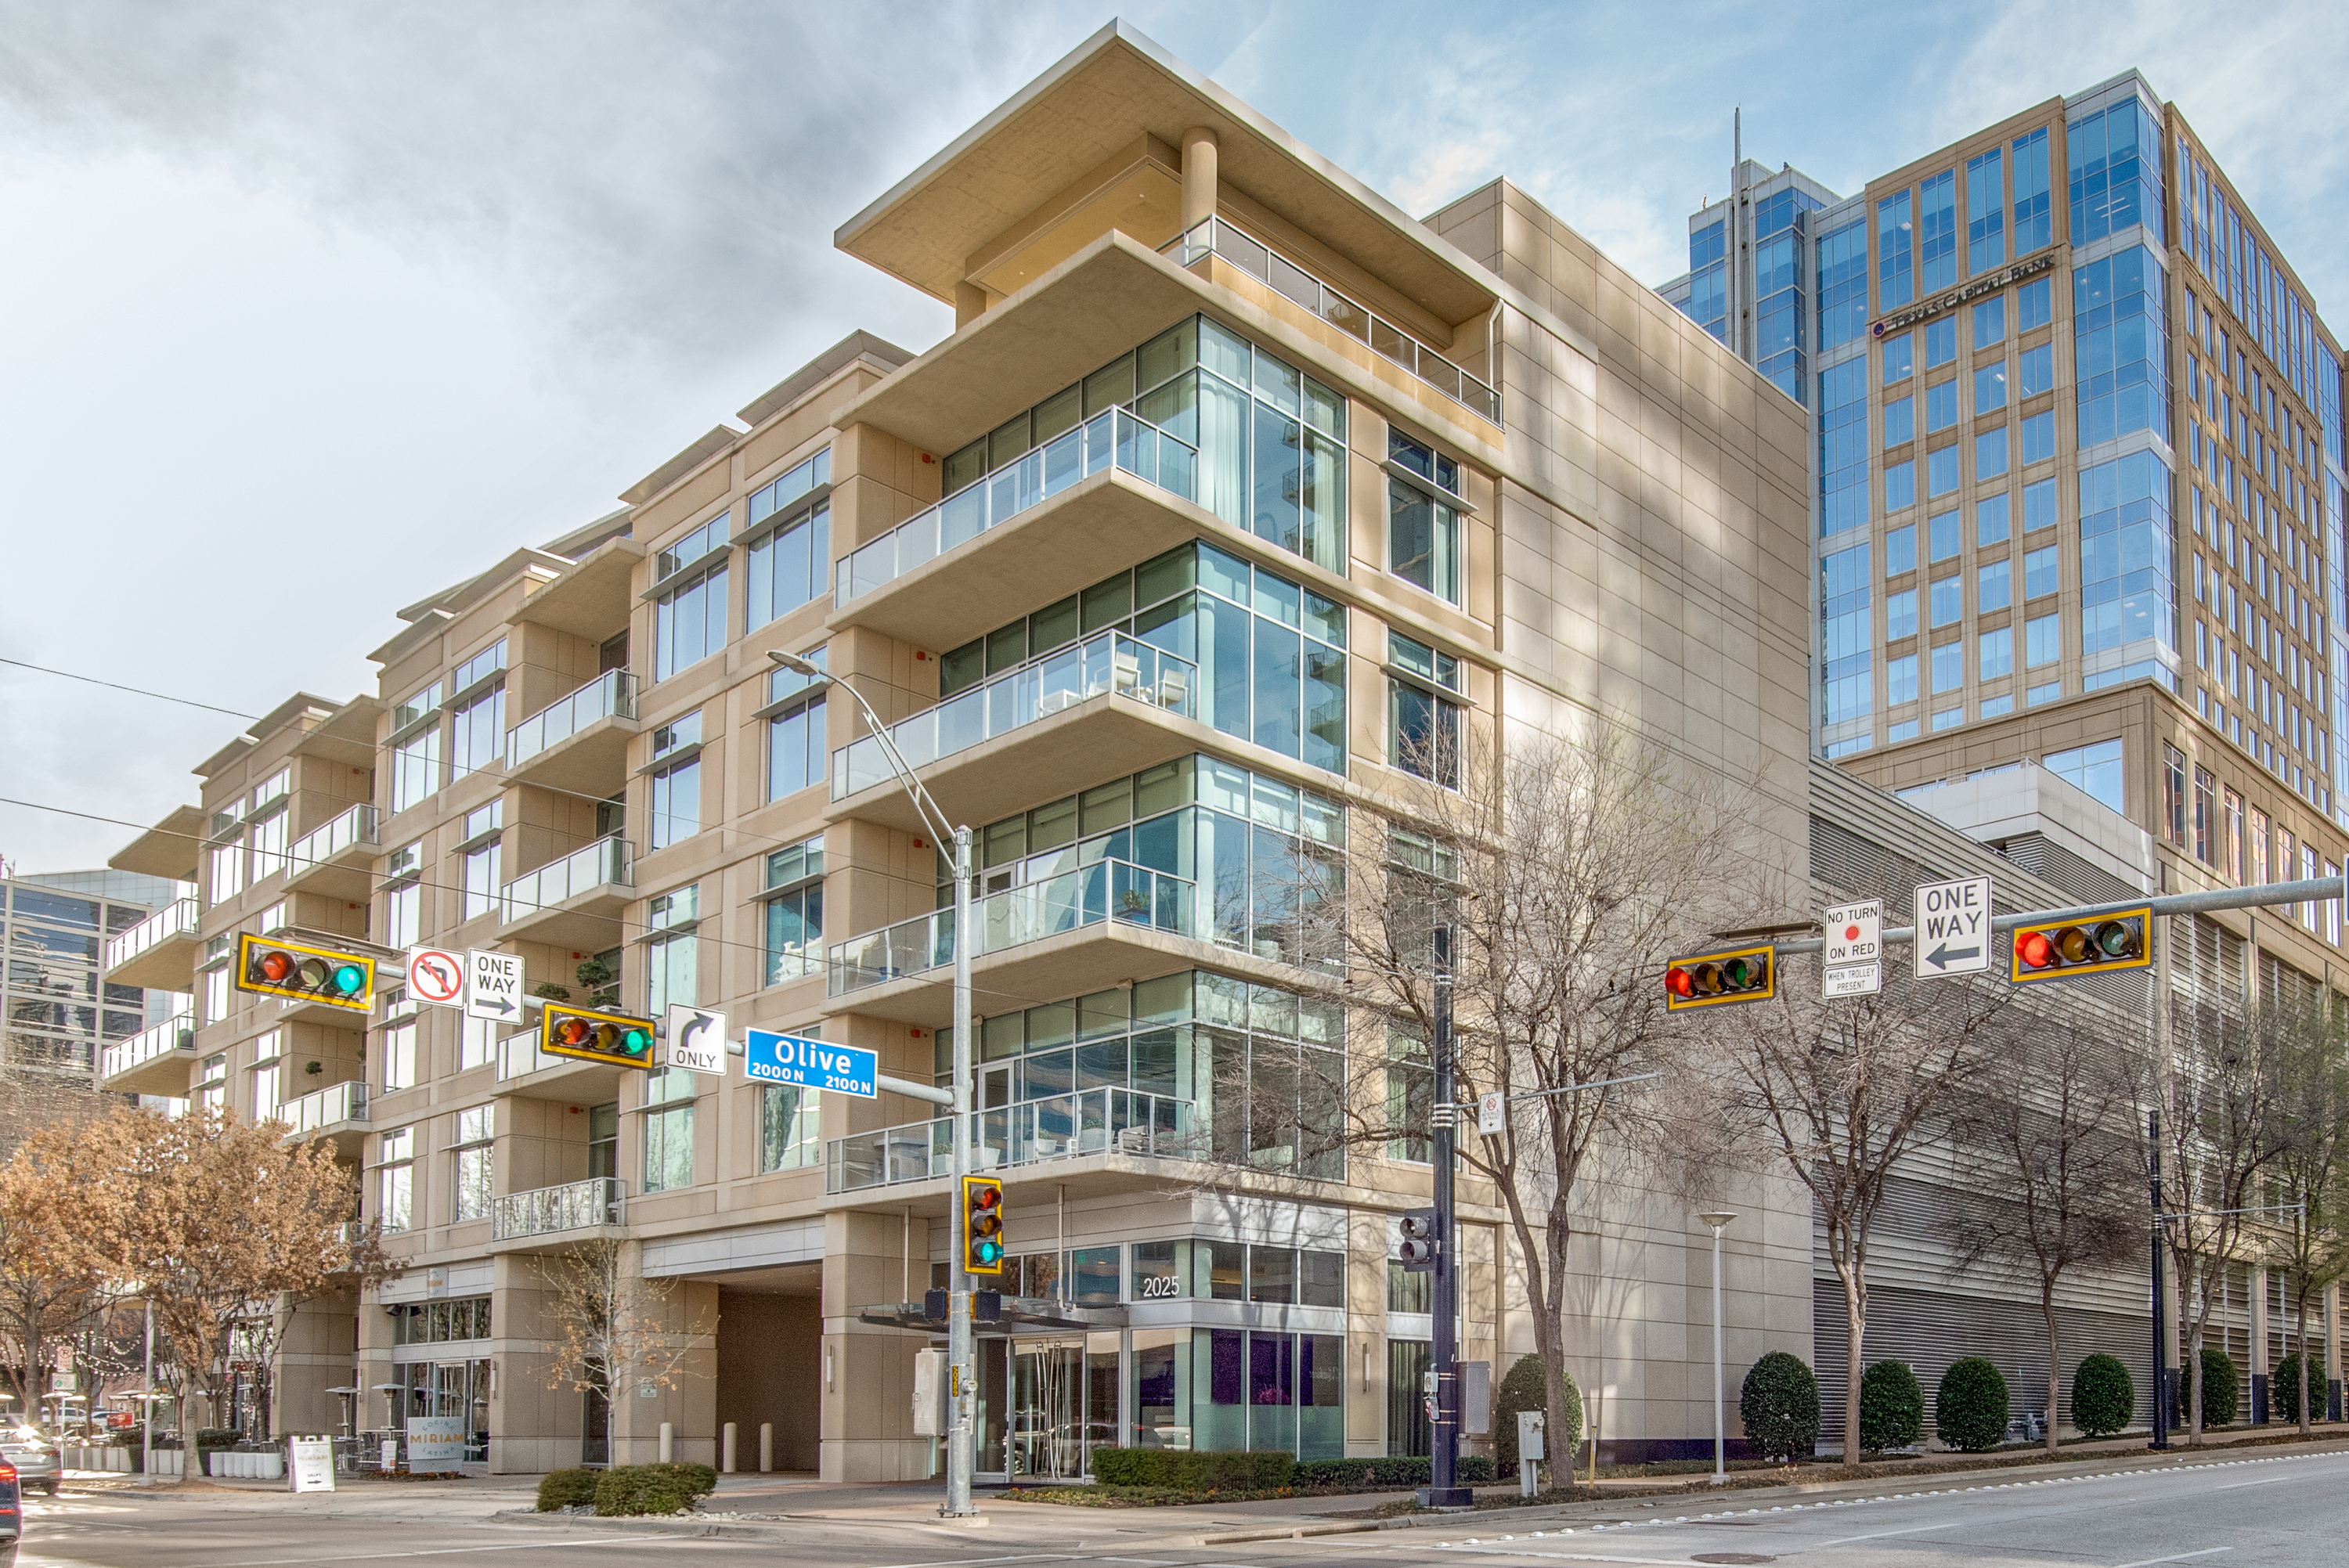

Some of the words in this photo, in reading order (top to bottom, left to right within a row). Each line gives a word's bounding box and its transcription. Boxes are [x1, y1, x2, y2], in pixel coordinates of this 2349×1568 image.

[1892, 301, 1939, 330] TEXAS
[1943, 273, 2004, 308] CAPITAL
[2010, 254, 2055, 282] BANK
[1927, 884, 1978, 912] ONE
[1828, 912, 1842, 924] NO
[1848, 906, 1878, 921] TURN
[1927, 910, 1983, 939] WAY
[1830, 946, 1846, 959] ON
[1852, 943, 1875, 956] RED
[478, 957, 514, 976] ONE
[1828, 971, 1845, 982] WHEN
[1848, 968, 1875, 979] TROLLEY
[478, 974, 515, 993] WAY
[1836, 980, 1865, 992] PRESENT
[677, 1050, 716, 1068] ONLY
[774, 1040, 852, 1074] Olive
[752, 1062, 792, 1080] 2000
[794, 1069, 804, 1083] N
[825, 1074, 859, 1091] 2100
[861, 1081, 871, 1094] N
[1143, 1276, 1180, 1297] 2025
[410, 1433, 464, 1444] MIRIAM
